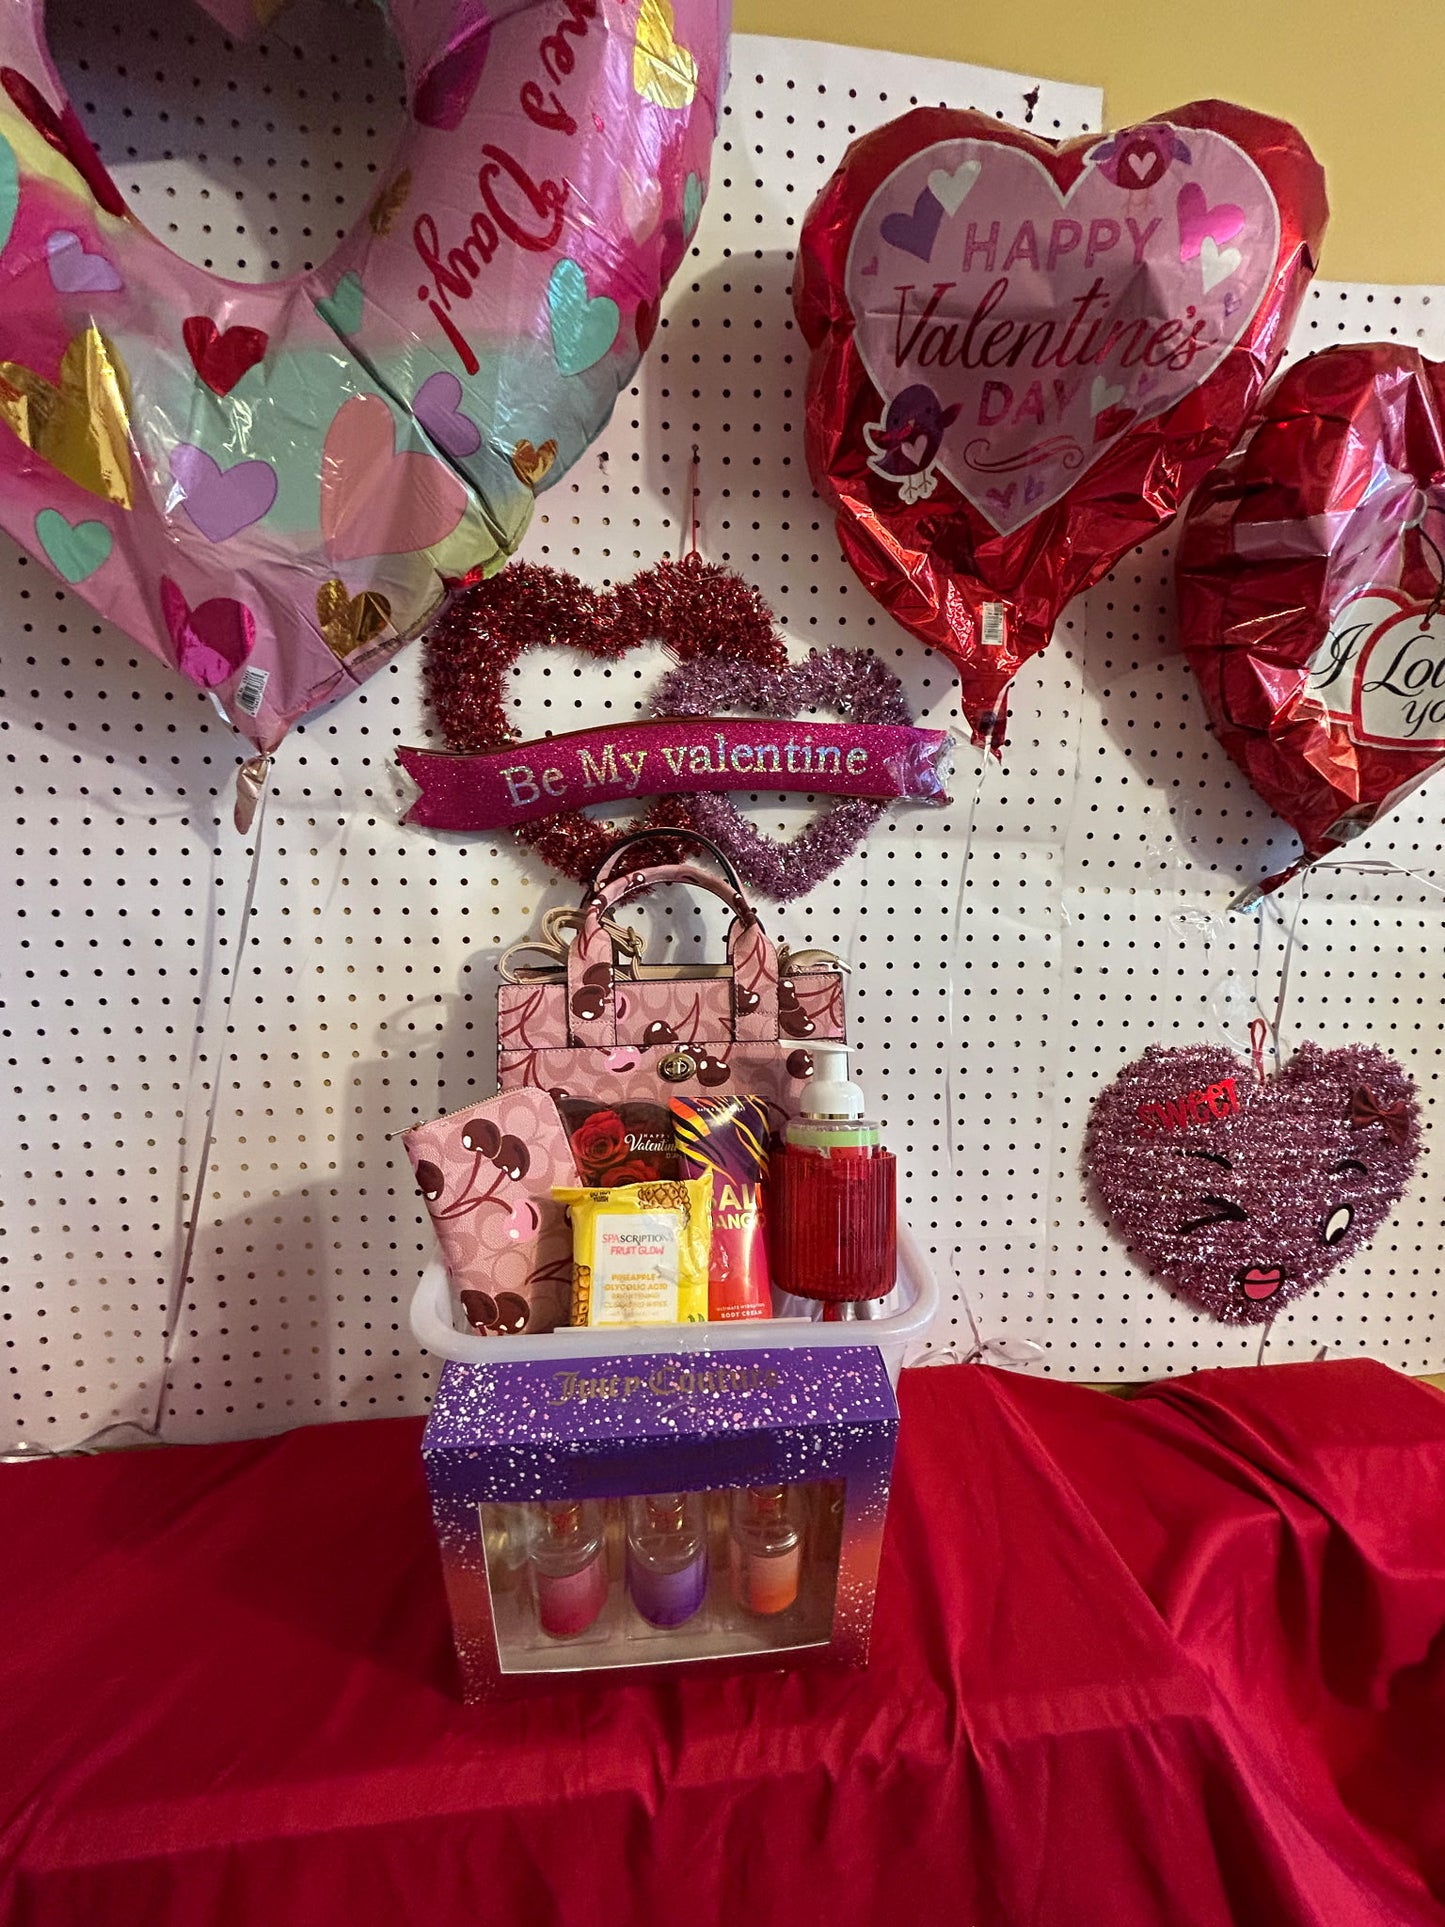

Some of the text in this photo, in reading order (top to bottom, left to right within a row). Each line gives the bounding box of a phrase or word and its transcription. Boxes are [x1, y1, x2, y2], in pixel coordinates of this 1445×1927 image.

[413, 144, 570, 375] Day!
[962, 217, 1162, 272] HAPPY
[893, 278, 1218, 371] Valentine's
[977, 379, 1081, 426] DAY
[1310, 622, 1373, 690] I
[500, 732, 868, 808] Be My valentine
[610, 1246, 664, 1255] FRUIT GLOW
[550, 1370, 640, 1406] Juicy
